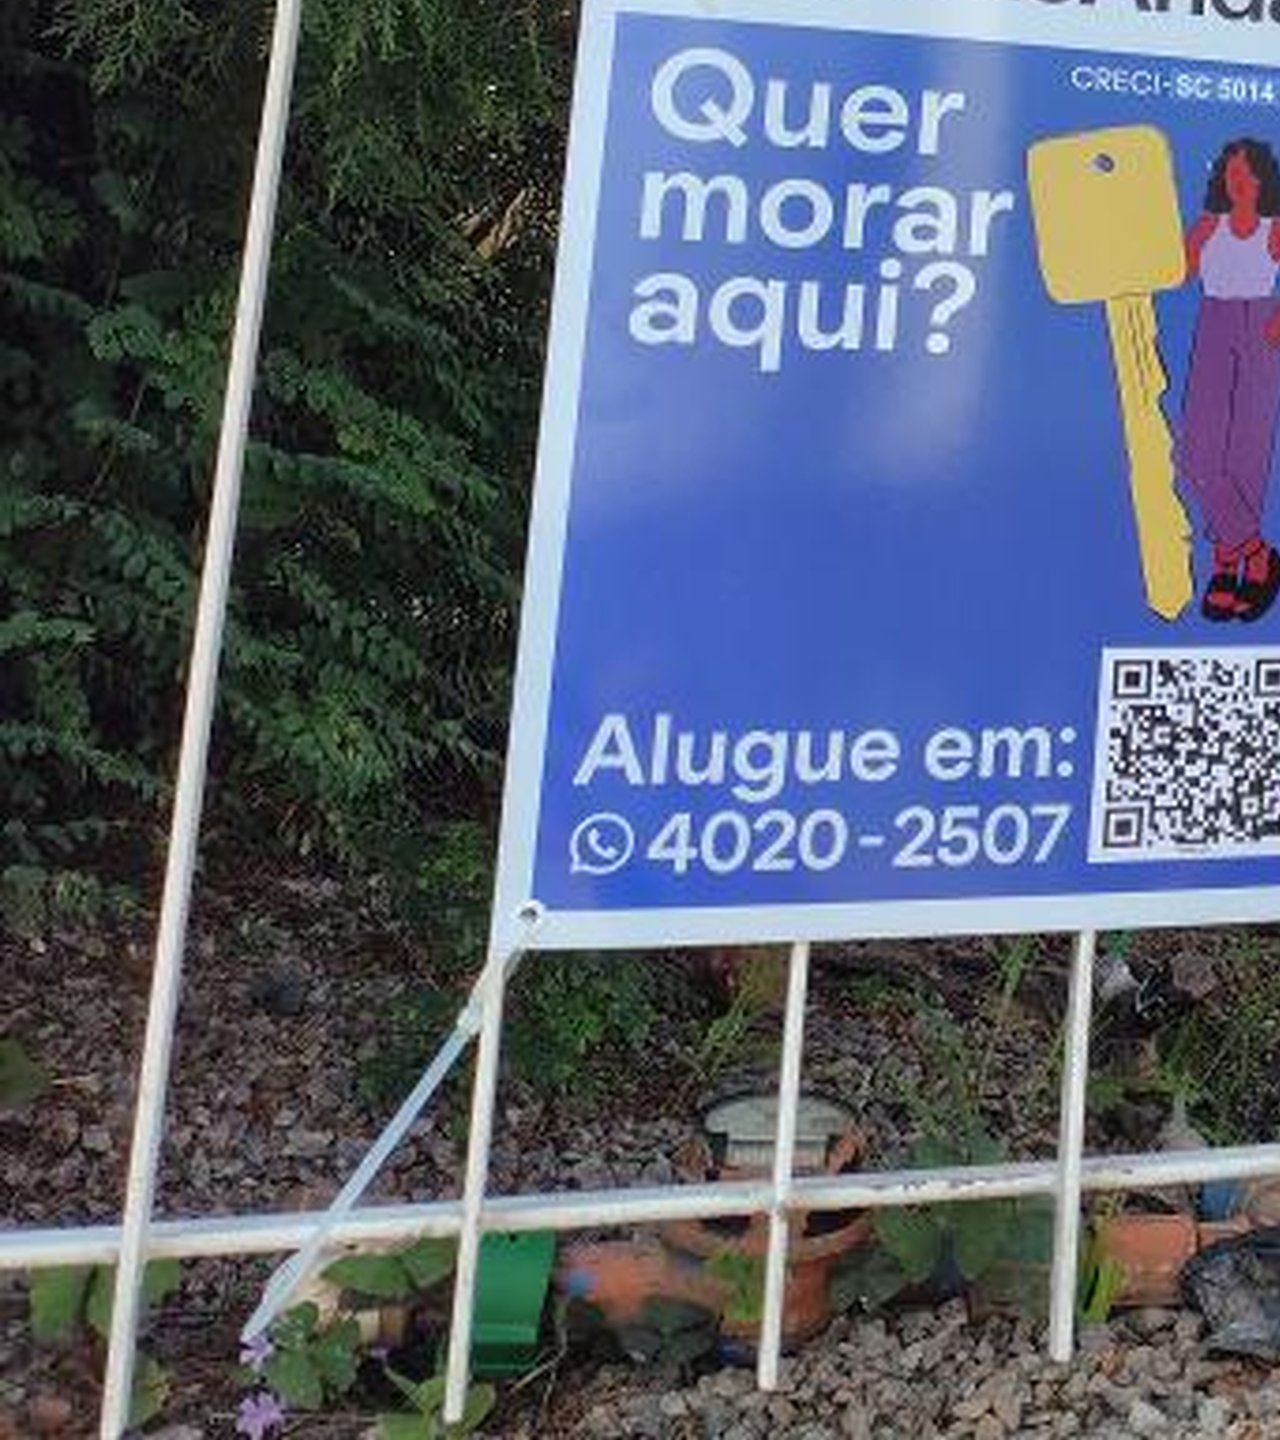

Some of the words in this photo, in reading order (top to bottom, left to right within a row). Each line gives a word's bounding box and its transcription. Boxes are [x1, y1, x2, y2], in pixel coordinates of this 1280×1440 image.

[650, 47, 967, 157] Quer
[1217, 78, 1275, 102] 5014
[638, 167, 1015, 258] morar
[628, 258, 977, 372] aqui?
[572, 712, 899, 802] Alugue
[924, 722, 1076, 780] em:
[646, 803, 1072, 873] 4020-2507
